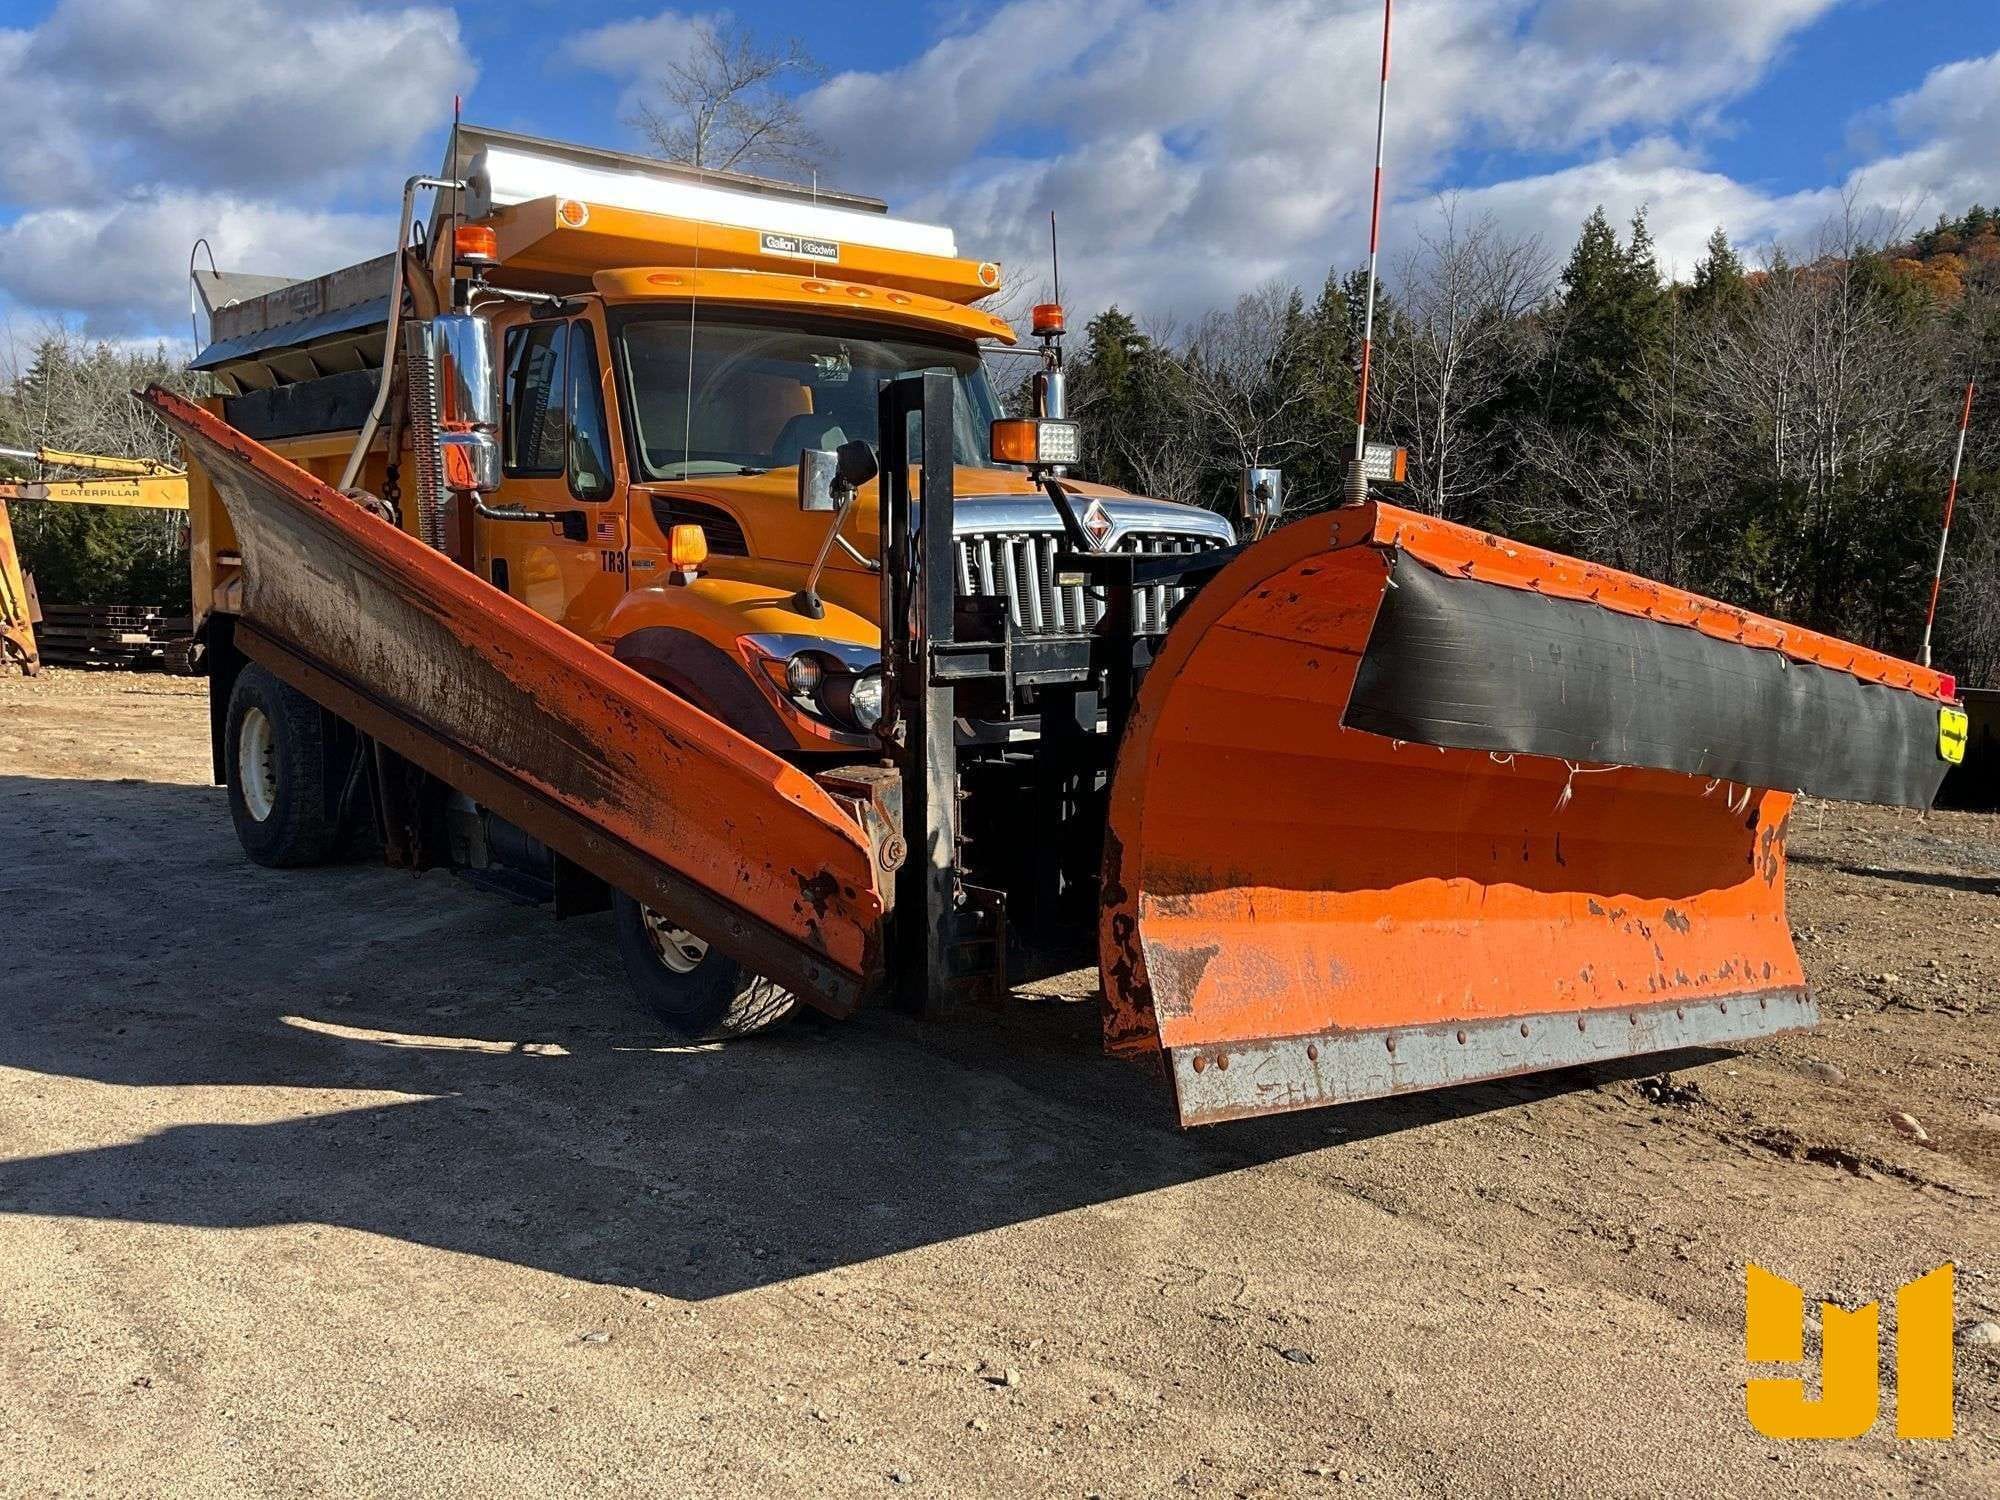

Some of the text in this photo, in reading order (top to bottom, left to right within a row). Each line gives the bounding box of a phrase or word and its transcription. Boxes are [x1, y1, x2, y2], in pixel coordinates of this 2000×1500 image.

[766, 236, 795, 251] Galion
[808, 243, 836, 256] Godwin
[61, 489, 140, 497] CATERPILLAR
[601, 550, 625, 574] TR3
